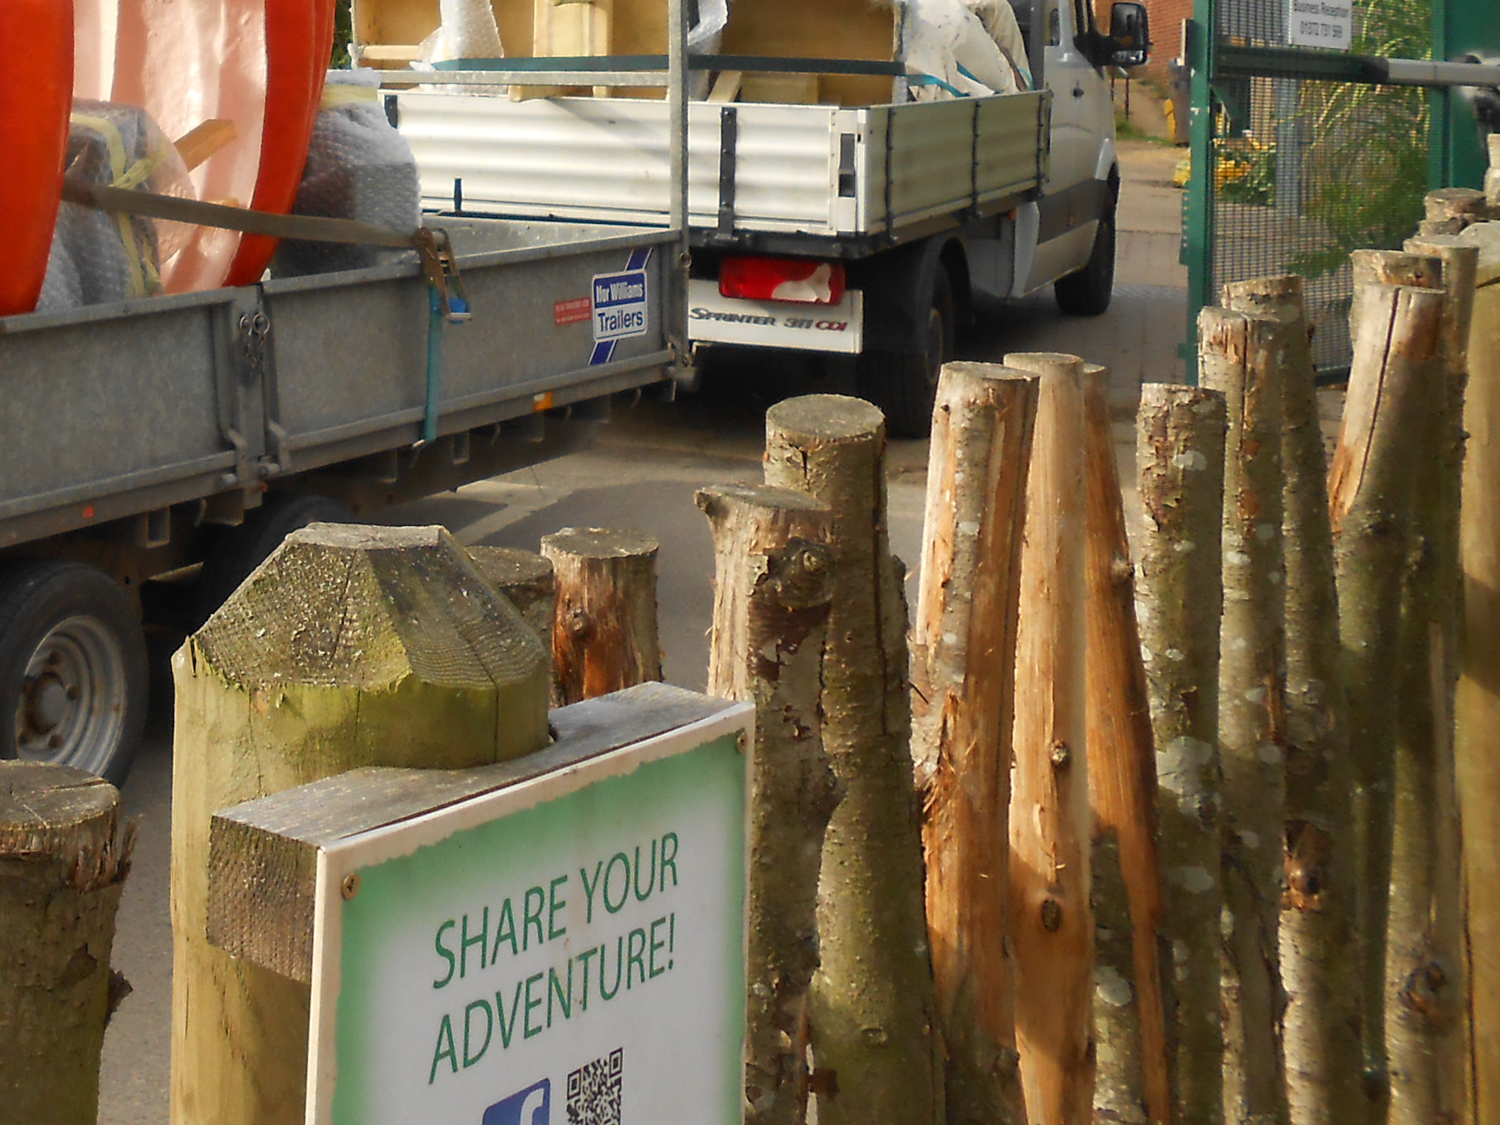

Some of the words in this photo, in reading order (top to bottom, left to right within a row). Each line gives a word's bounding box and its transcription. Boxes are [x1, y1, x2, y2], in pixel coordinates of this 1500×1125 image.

[1321, 2, 1349, 19] Reception
[610, 281, 643, 302] Williams
[598, 309, 644, 333] Trailers
[816, 320, 848, 332] CDI
[433, 875, 568, 990] SHARE
[580, 832, 679, 924] YOUR
[429, 912, 675, 1085] ADVENTURE!
